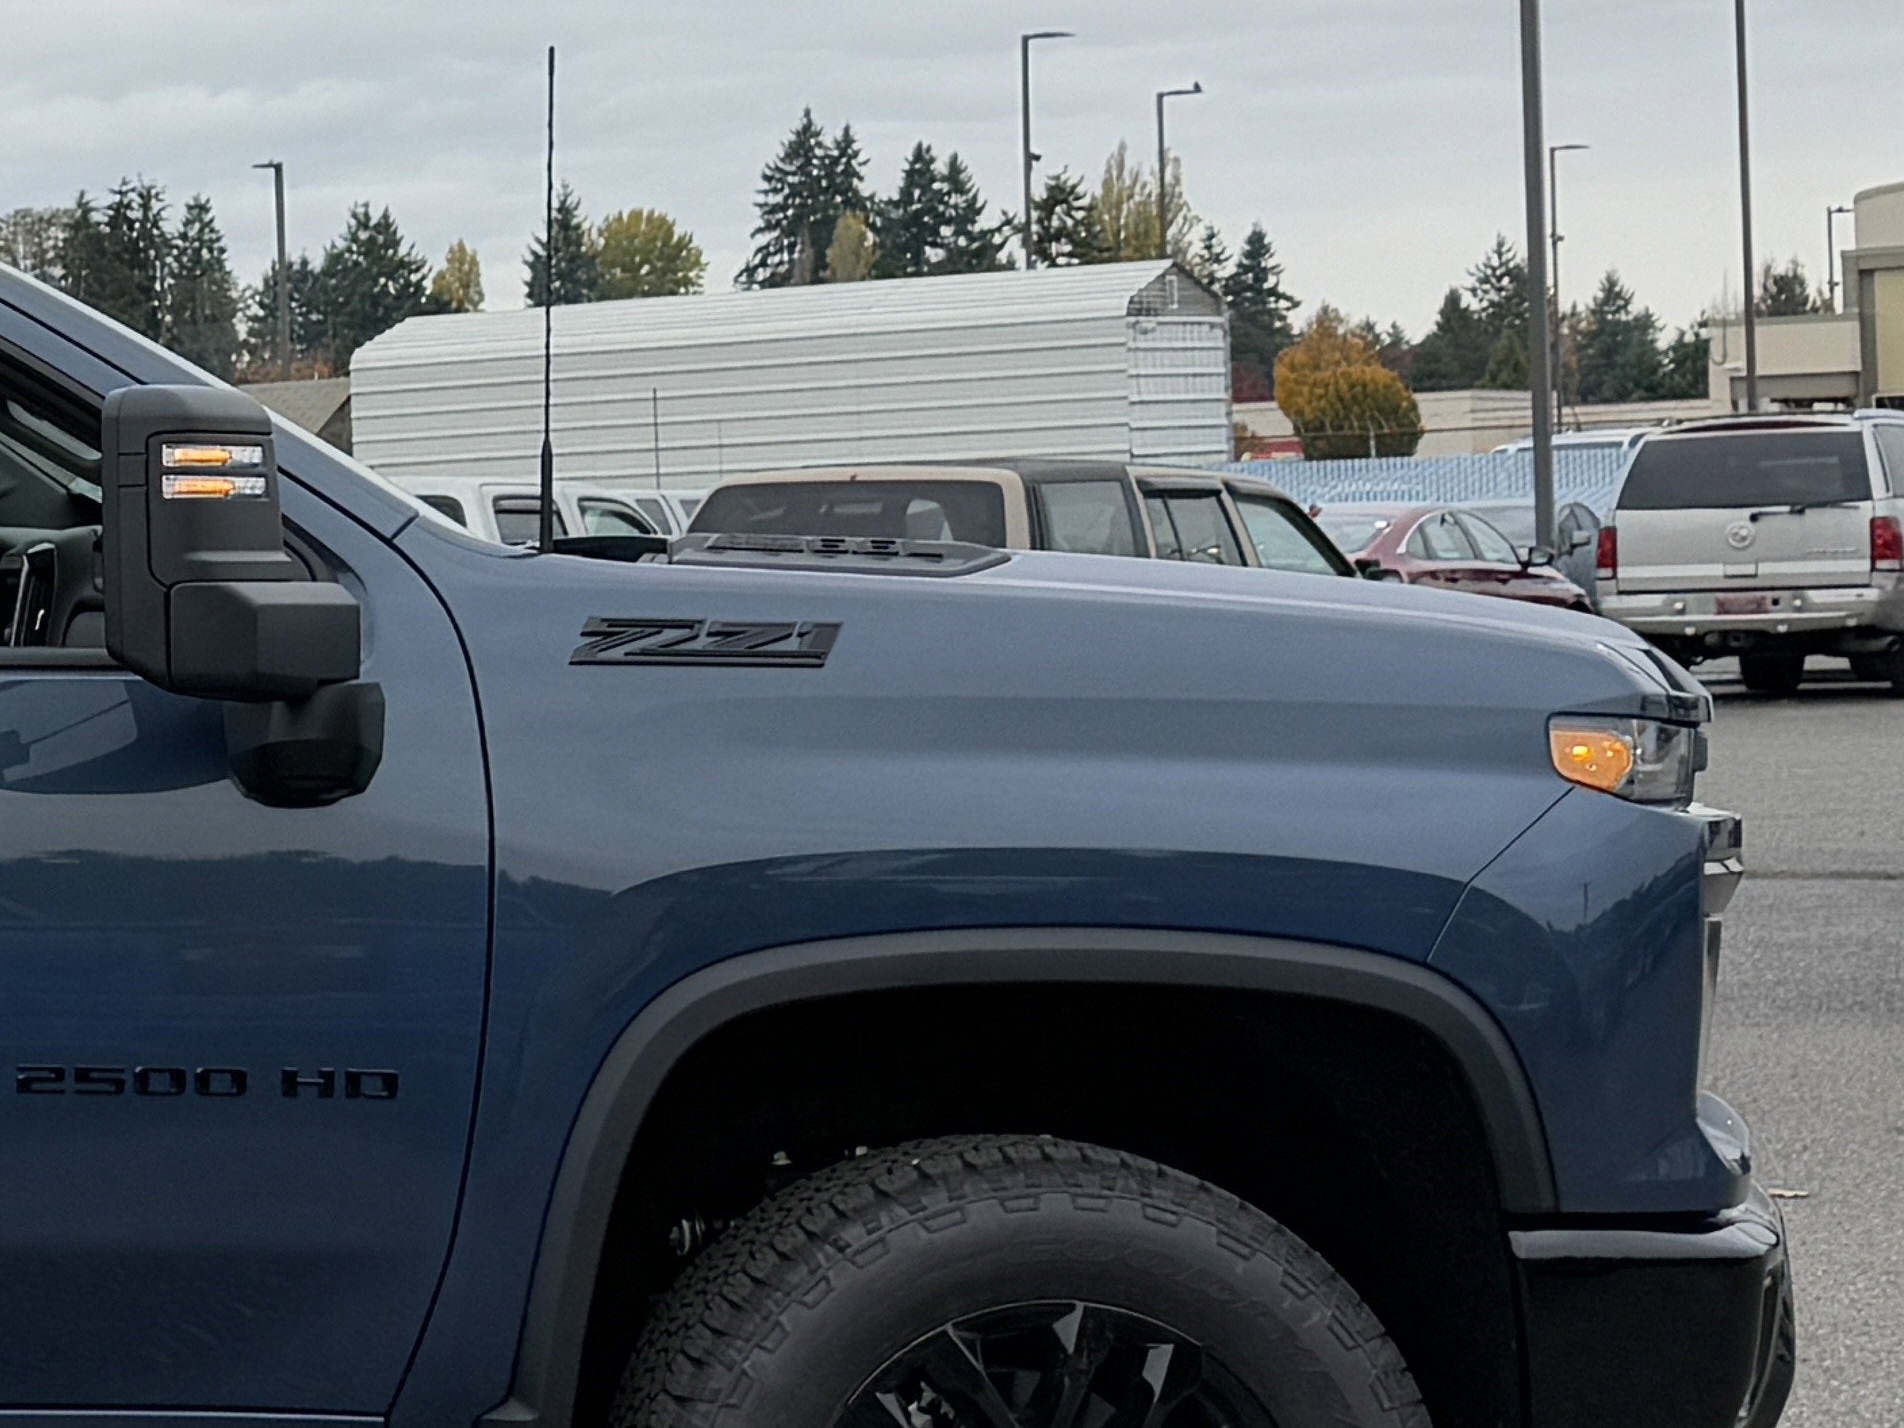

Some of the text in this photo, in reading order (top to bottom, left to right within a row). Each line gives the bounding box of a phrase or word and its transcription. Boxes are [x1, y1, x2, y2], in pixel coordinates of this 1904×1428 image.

[568, 616, 843, 668] Z71
[15, 1064, 400, 1100] 2500 HD
